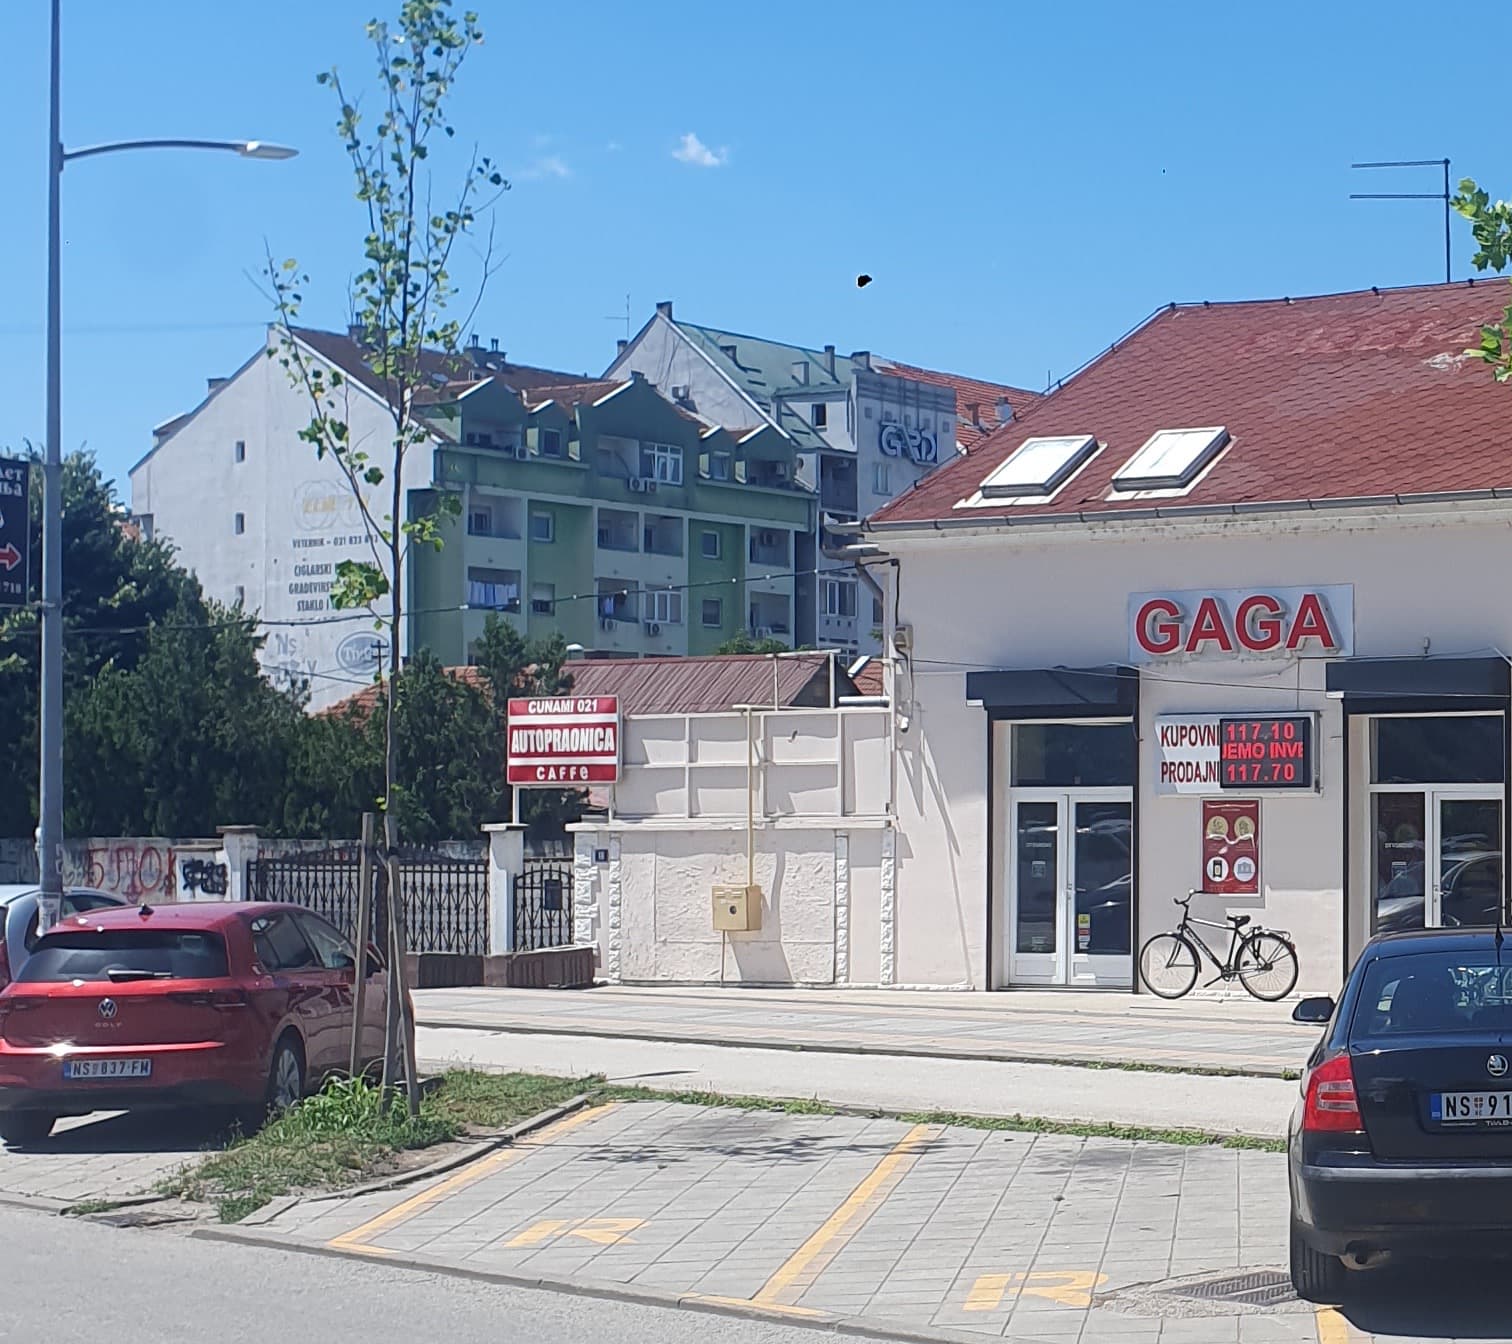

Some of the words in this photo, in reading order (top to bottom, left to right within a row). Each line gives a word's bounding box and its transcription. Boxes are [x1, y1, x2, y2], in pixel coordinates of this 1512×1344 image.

[1134, 594, 1337, 654] GAGA
[528, 700, 574, 714] CUNAMI
[577, 699, 598, 712] 021
[511, 727, 615, 753] AUTOPRAONICA
[1161, 725, 1220, 747] KUPOVNI
[1227, 722, 1294, 740] 117.10
[1161, 761, 1220, 783] PRODAJNI
[1227, 763, 1294, 782] 117.70
[73, 1063, 90, 1076] NS
[1446, 1096, 1470, 1117] NS
